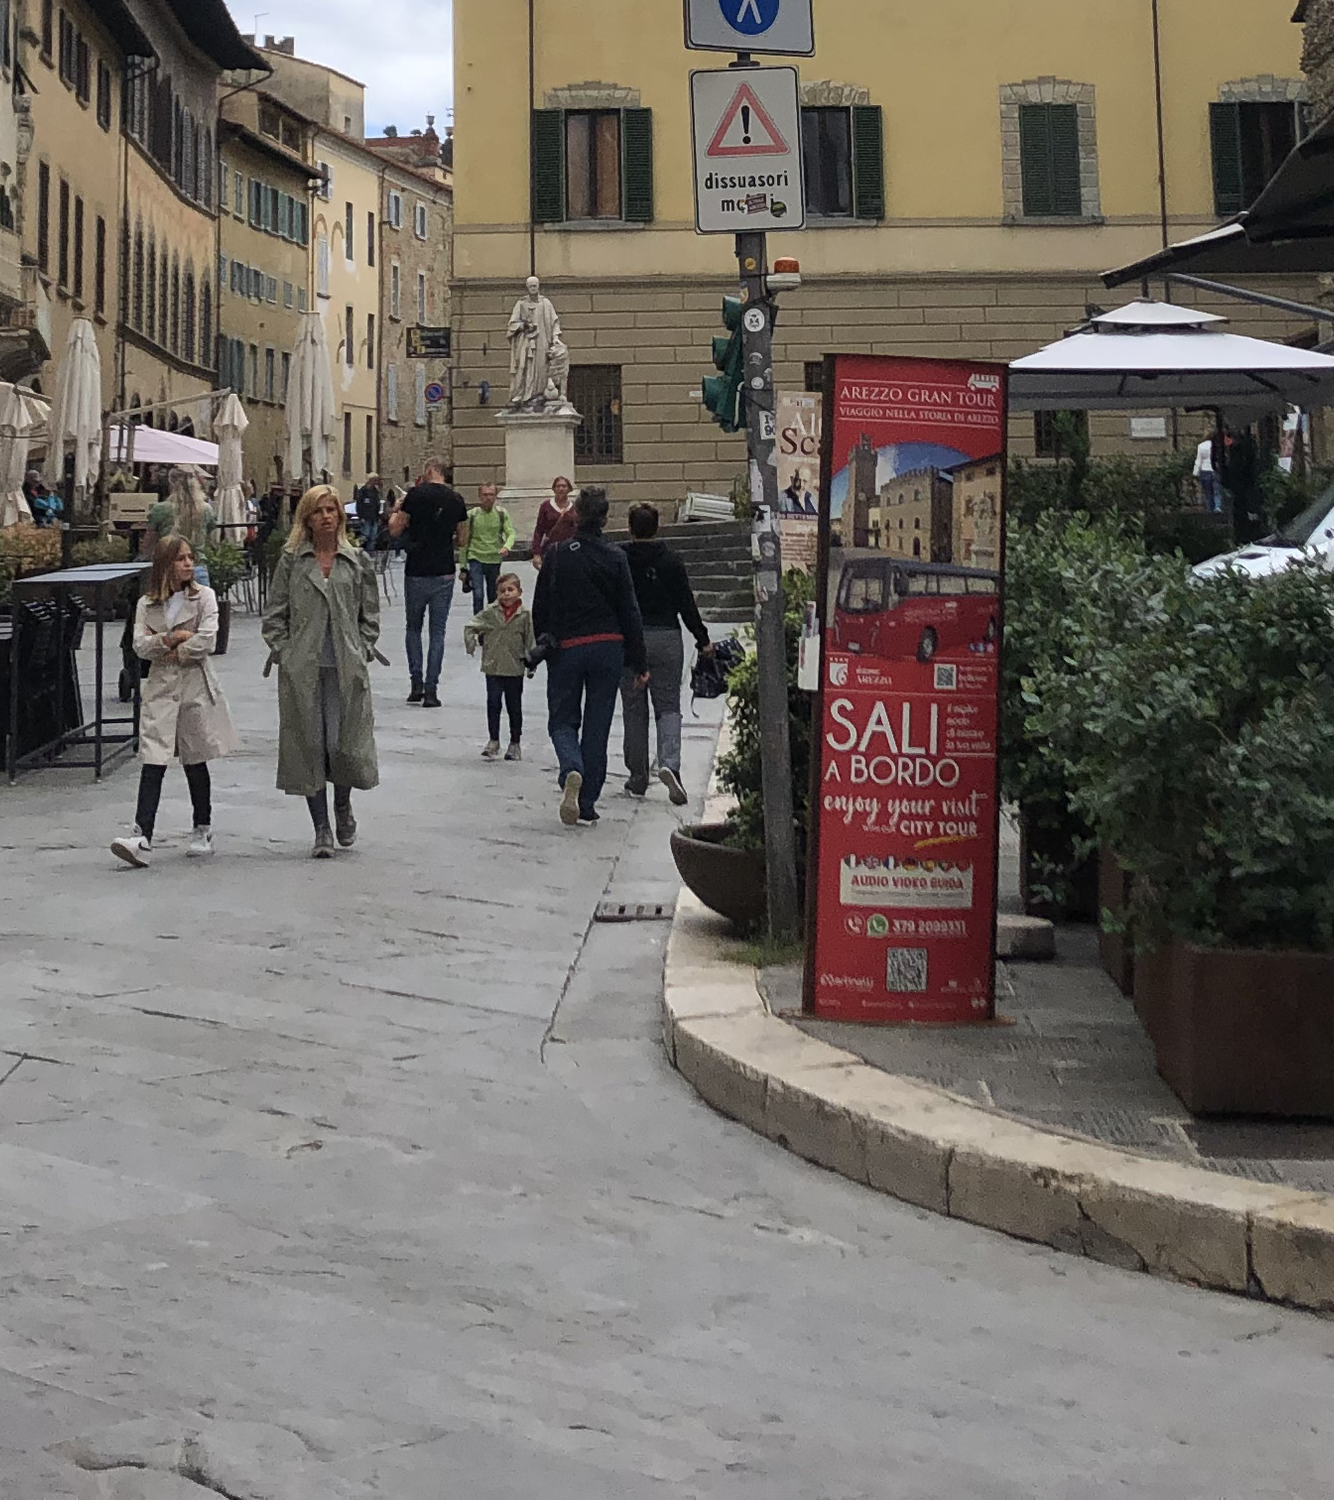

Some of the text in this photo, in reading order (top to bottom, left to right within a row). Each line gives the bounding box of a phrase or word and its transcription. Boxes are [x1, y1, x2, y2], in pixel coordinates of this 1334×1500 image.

[705, 171, 789, 190] dissuasori
[840, 386, 996, 408] AREZZO GRAN TOUR
[839, 406, 999, 425] VIAGGIO NELLA STORIA DI AREZZO
[780, 427, 821, 456] Sc
[826, 698, 938, 756] SALI
[824, 755, 960, 788] A BORDO
[823, 789, 986, 826] enjoy your visit
[900, 820, 934, 836] CITY
[937, 820, 978, 837] TOUR
[851, 874, 965, 890] AUDIO VIDEO GUIDA
